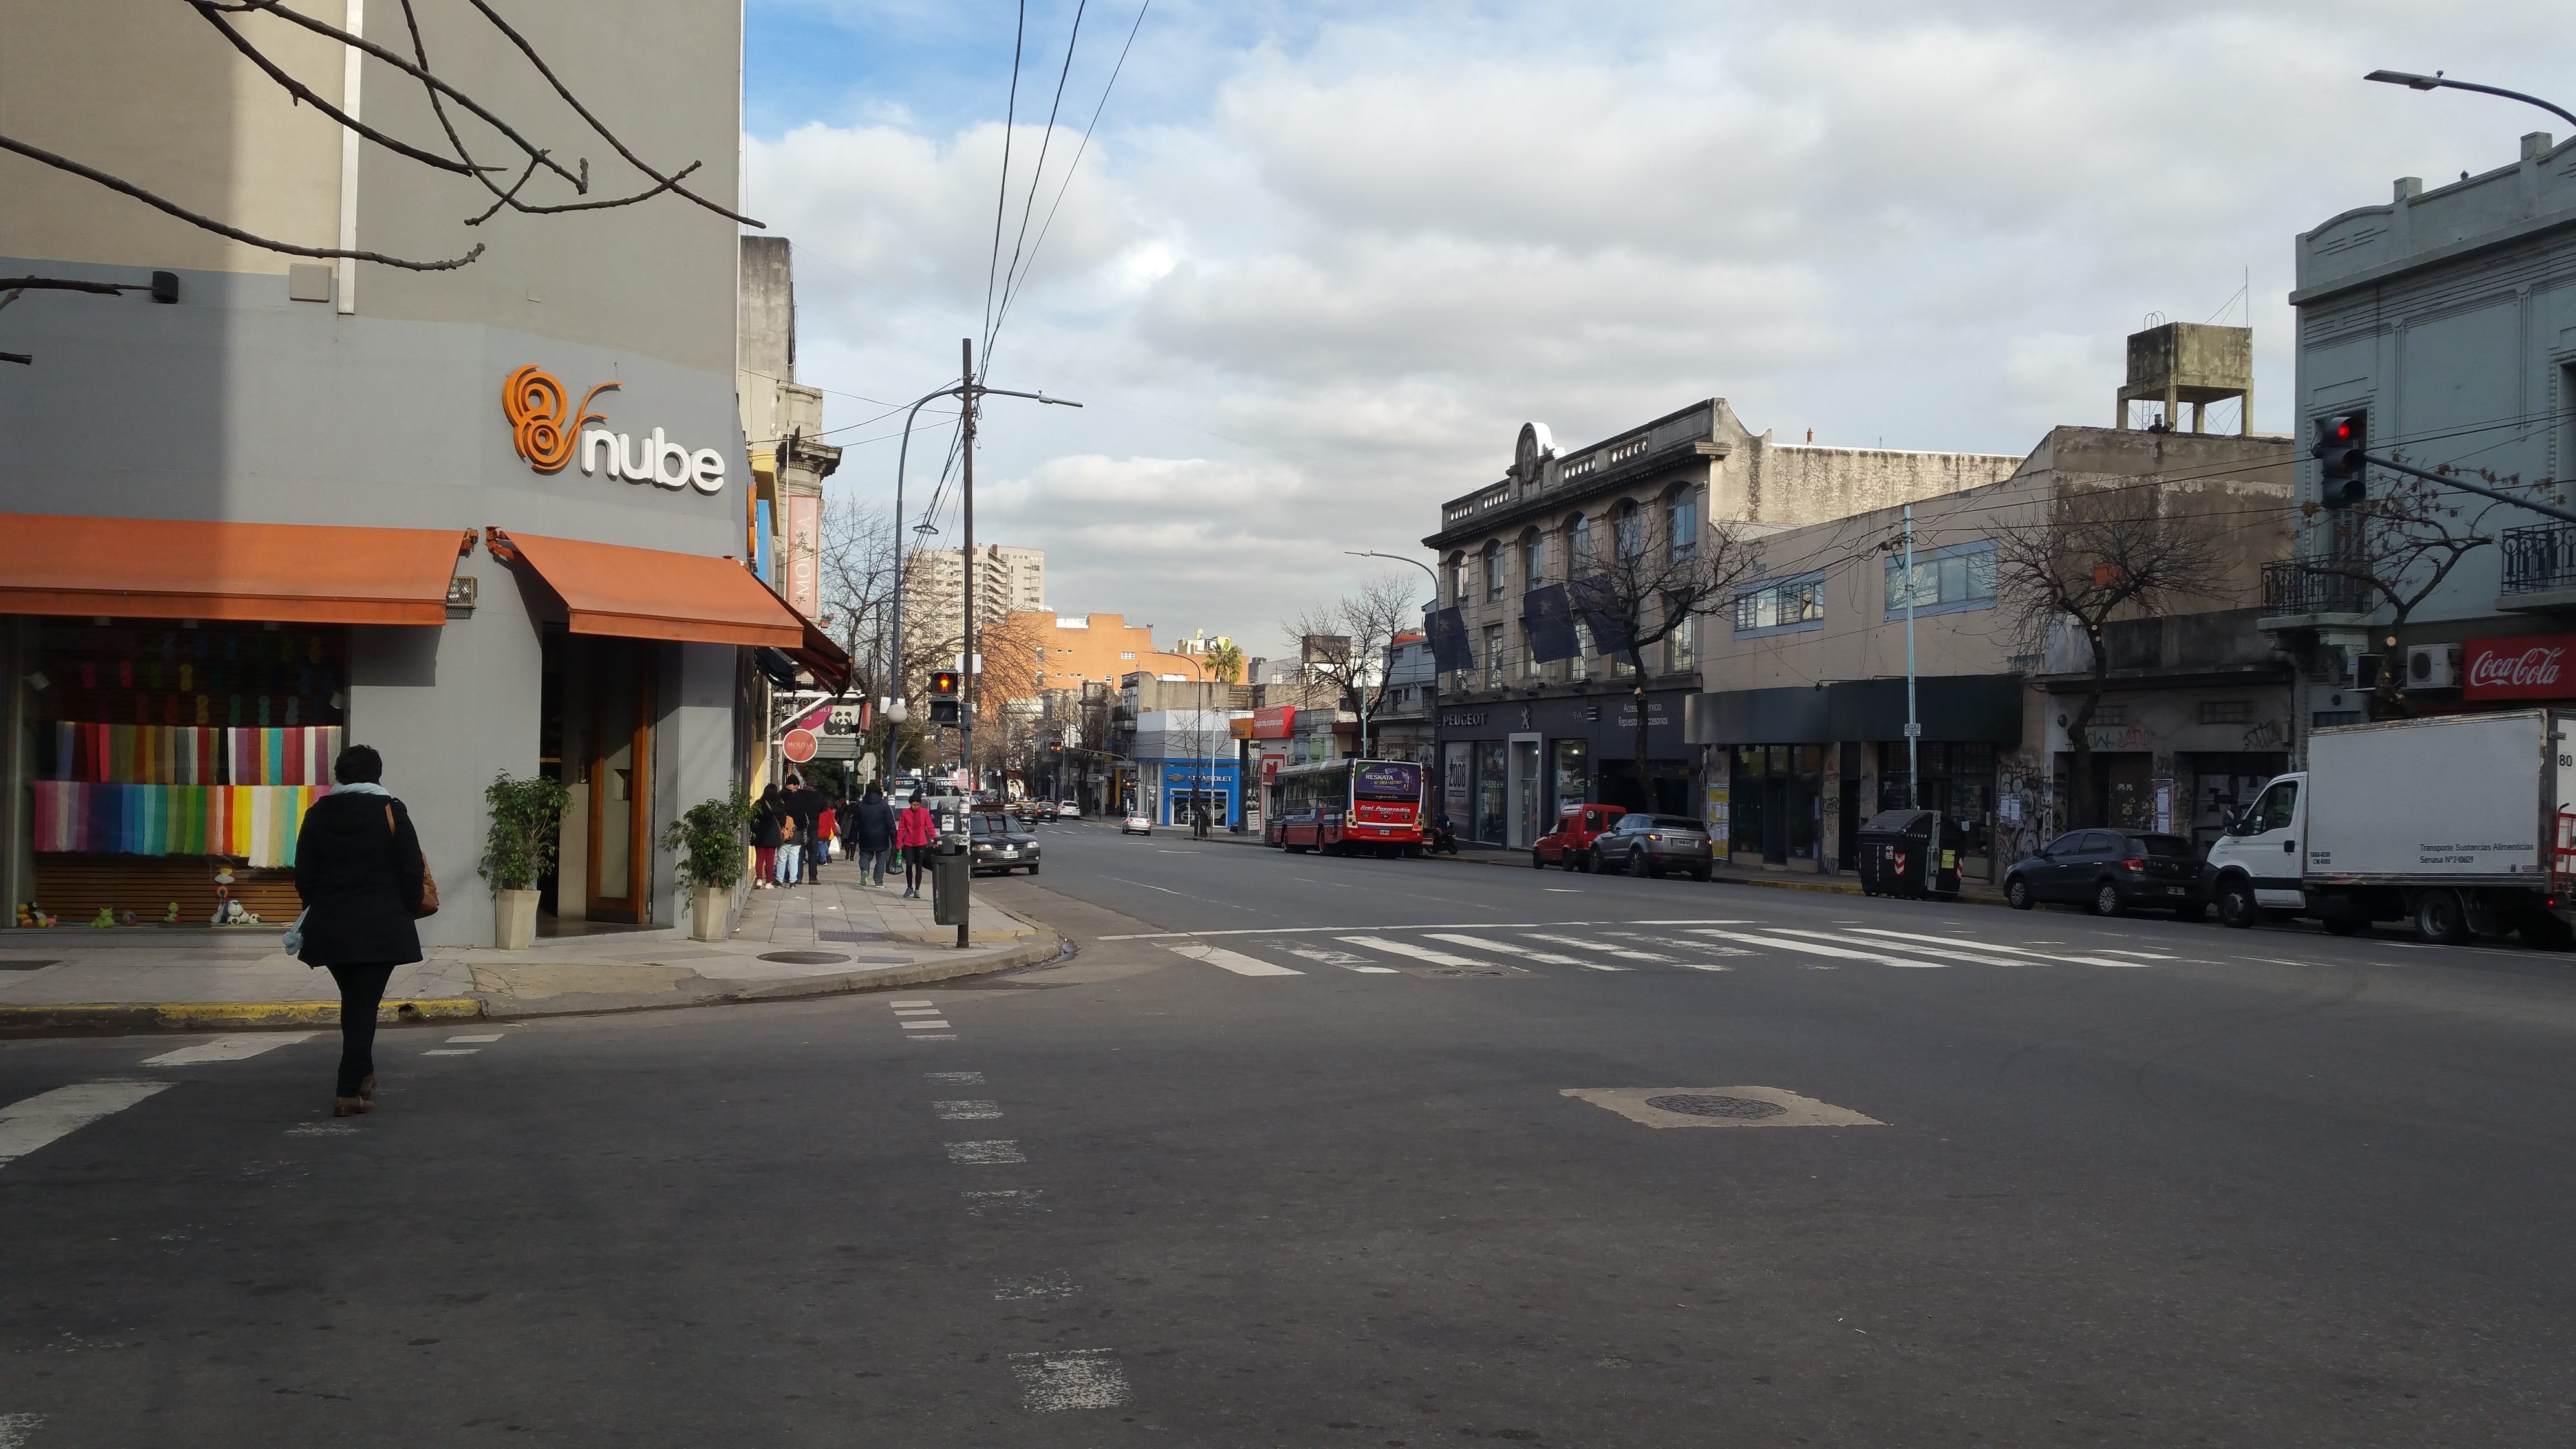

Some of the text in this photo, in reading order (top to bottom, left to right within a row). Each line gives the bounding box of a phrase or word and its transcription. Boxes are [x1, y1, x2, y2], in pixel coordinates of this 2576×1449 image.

[581, 427, 725, 493] nube
[2470, 647, 2565, 686] Coca-Cola
[1443, 713, 1486, 726] PEUGEOT
[2559, 755, 2572, 767] 80
[1449, 763, 1466, 788] 2008
[2420, 844, 2453, 853] Transporte
